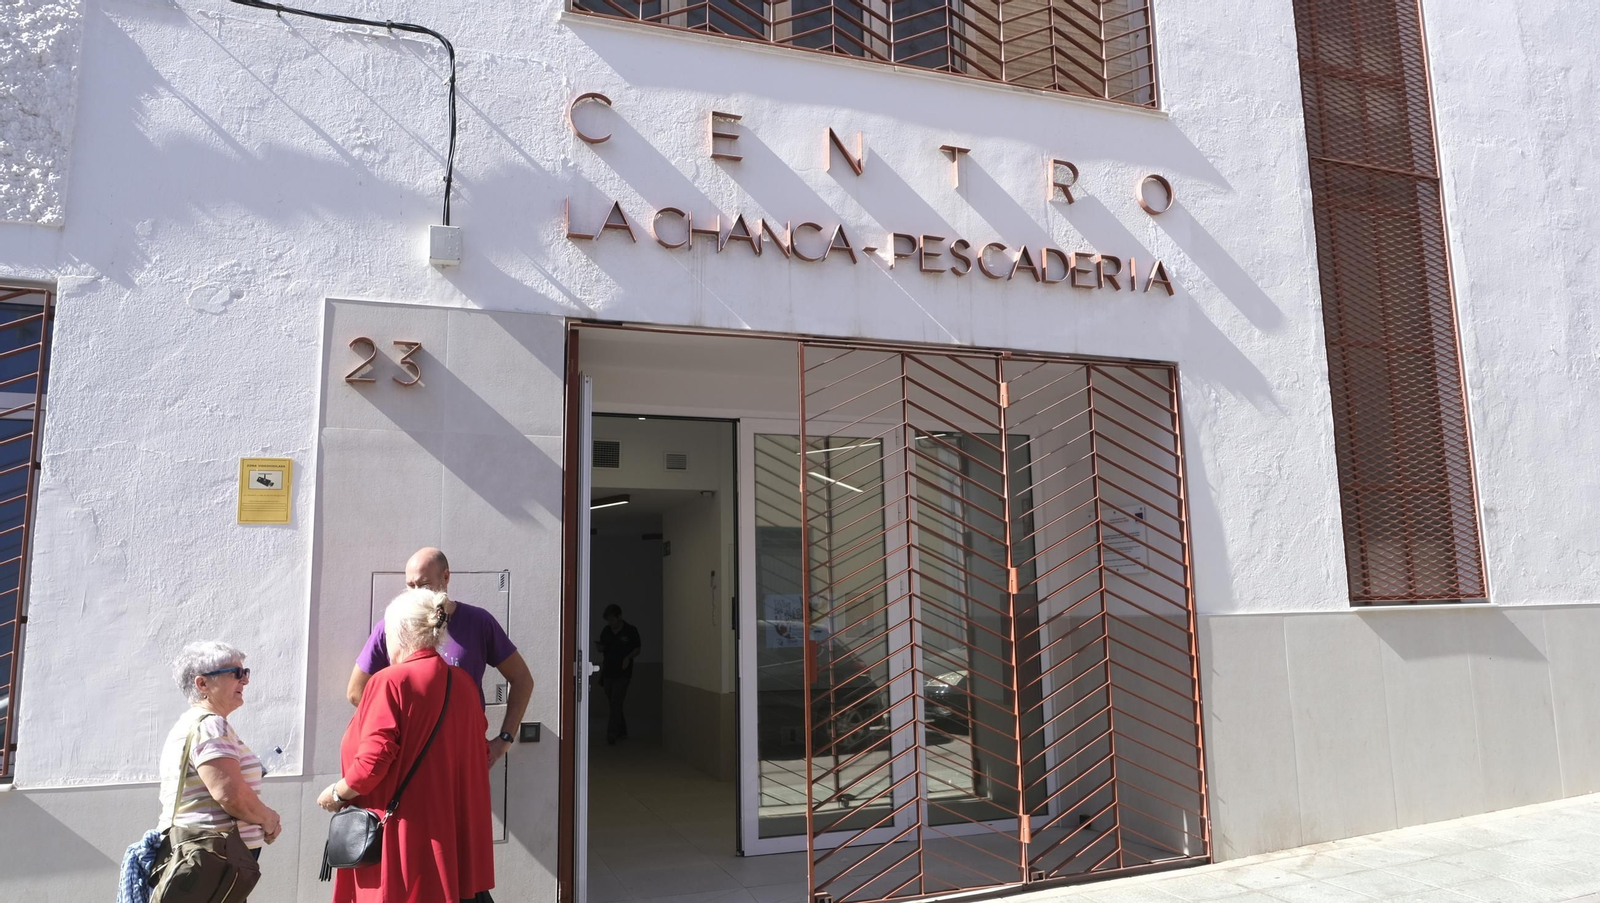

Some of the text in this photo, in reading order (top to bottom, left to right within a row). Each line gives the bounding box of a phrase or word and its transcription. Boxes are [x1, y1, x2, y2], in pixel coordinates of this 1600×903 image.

[568, 91, 1174, 215] CENTRO
[565, 196, 637, 244] LA
[345, 336, 422, 387] 23
